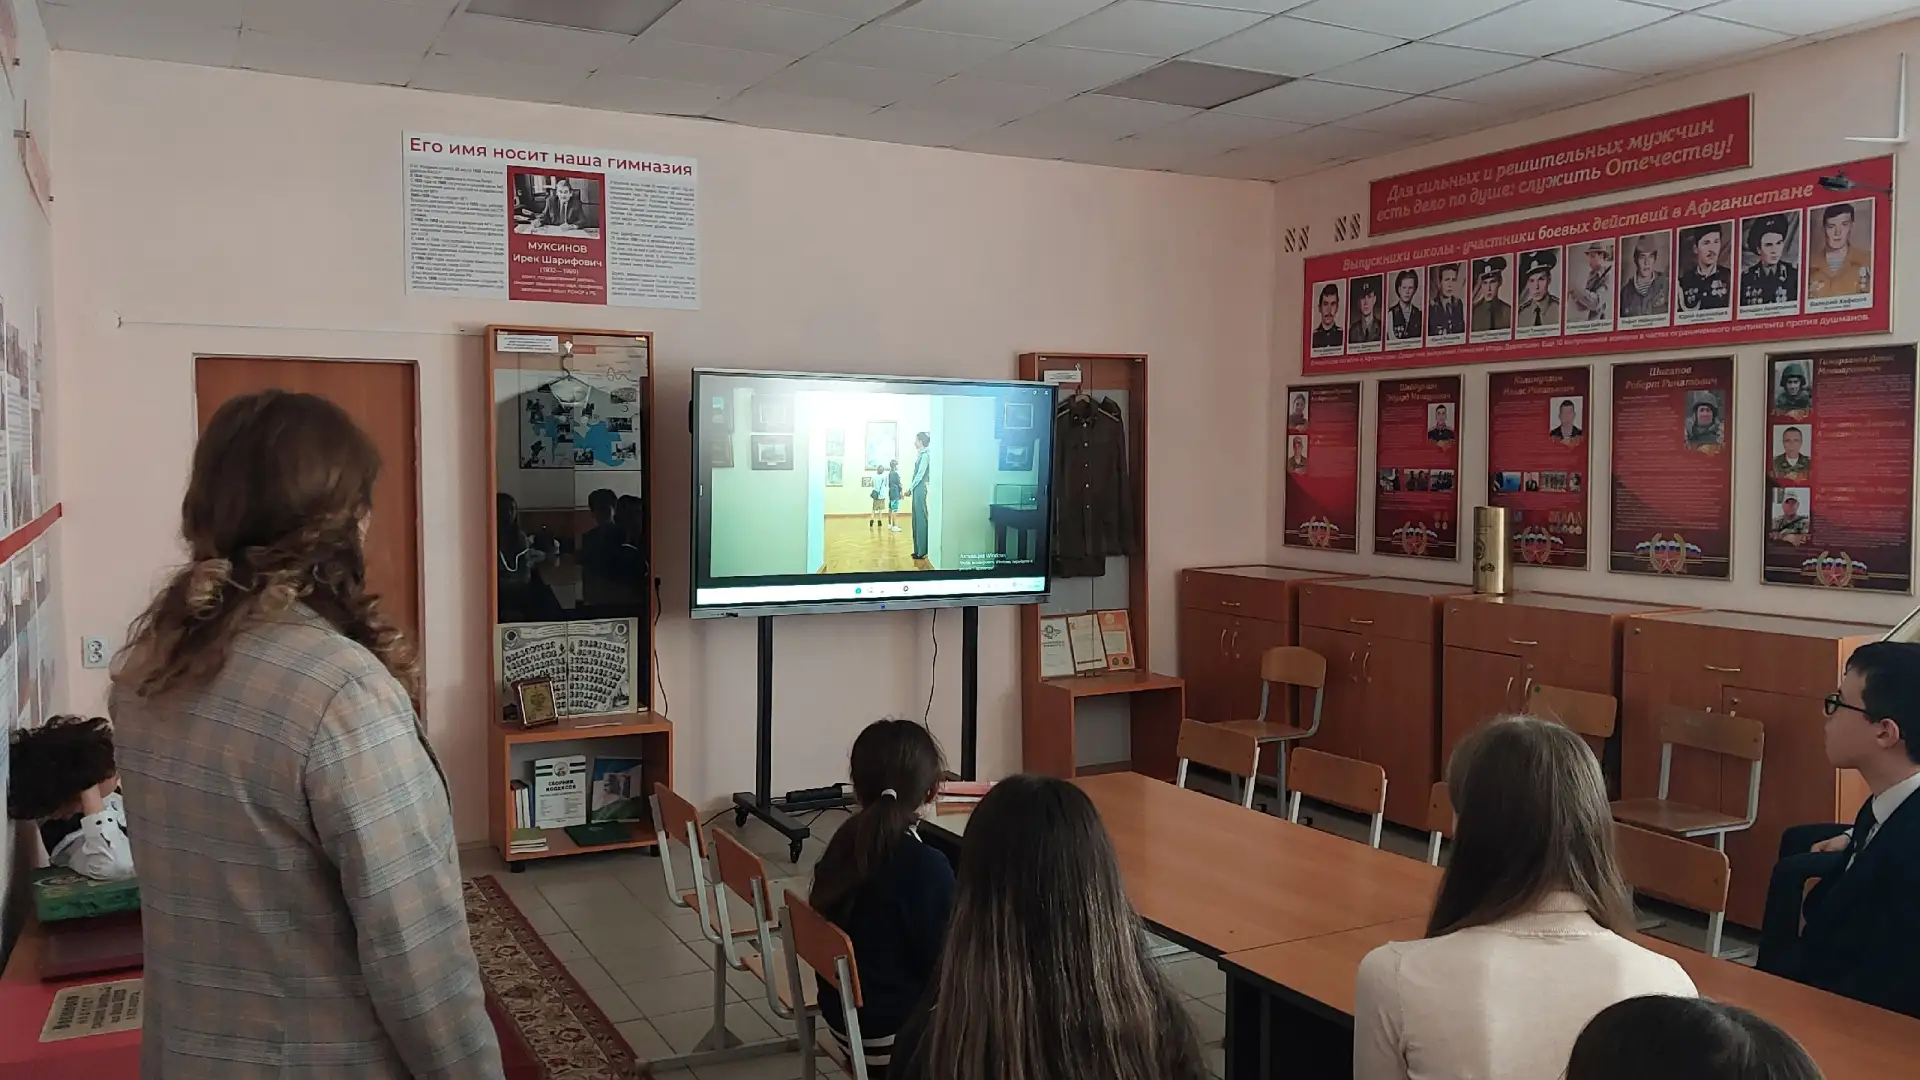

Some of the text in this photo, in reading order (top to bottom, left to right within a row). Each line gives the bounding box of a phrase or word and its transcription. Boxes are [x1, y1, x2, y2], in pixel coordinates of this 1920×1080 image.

[410, 137, 692, 176] Его имя носит наша гимназия
[1387, 118, 1715, 204] Для сильных и решительных мужчин
[1376, 133, 1735, 222] есть дело по душе: служить Отечеству!
[1342, 250, 1411, 271] Выпускники
[1413, 245, 1455, 260] школы
[1462, 232, 1535, 255] участники
[1538, 221, 1590, 240] боевых
[1592, 206, 1669, 232] действий
[1672, 208, 1682, 219] в
[1685, 183, 1814, 219] Афганистане
[513, 253, 602, 267] Ирек Шарифович
[527, 241, 588, 253] МУКСИНОВ
[1670, 325, 1731, 338] ограниченного
[1731, 321, 1785, 333] контингента
[1786, 318, 1819, 329] против
[1820, 314, 1869, 326] душманов.
[548, 779, 574, 787] СБОРНИК
